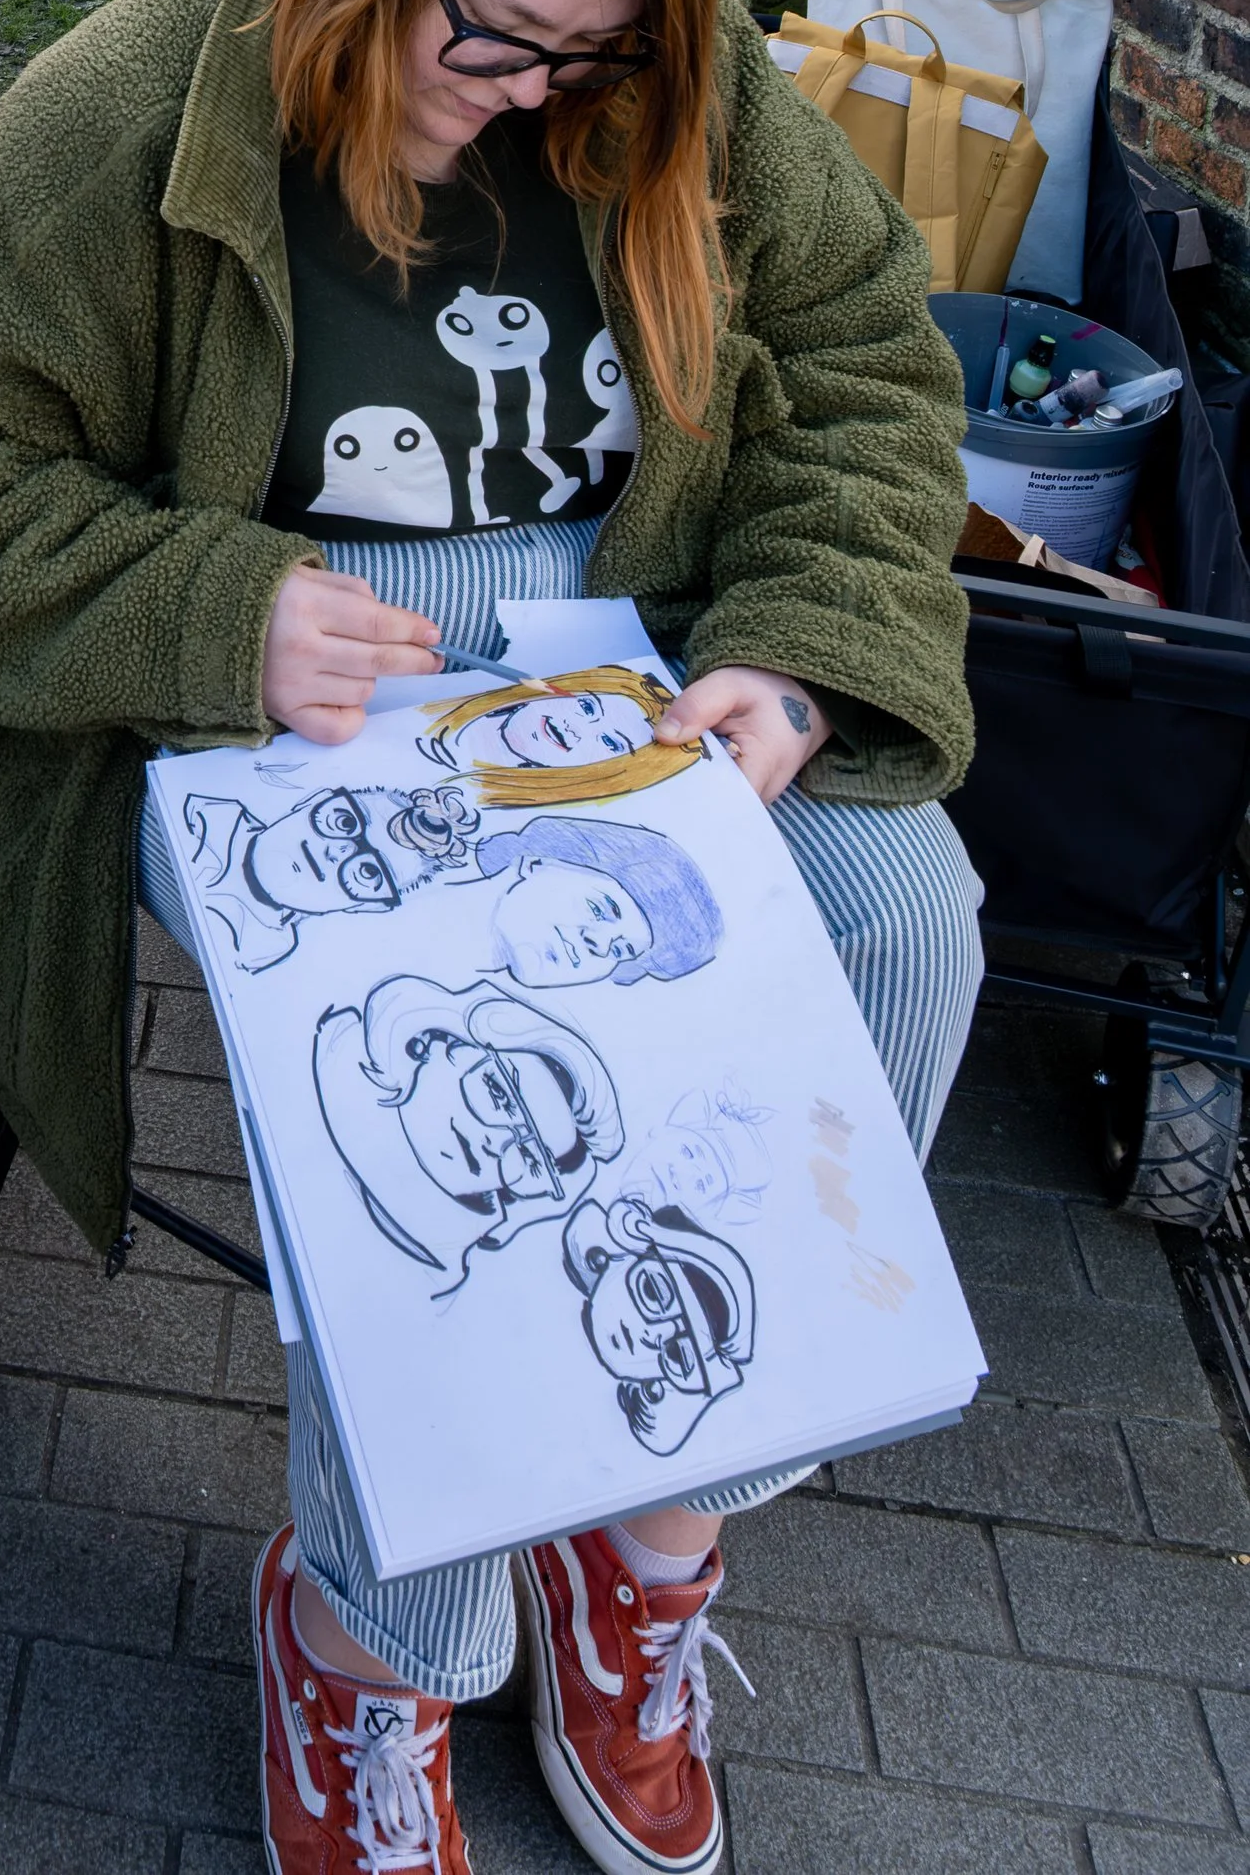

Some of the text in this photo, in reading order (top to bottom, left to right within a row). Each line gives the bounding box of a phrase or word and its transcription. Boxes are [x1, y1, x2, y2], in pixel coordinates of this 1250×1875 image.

[1030, 470, 1071, 482] Interior
[1073, 473, 1101, 483] ready
[1028, 481, 1056, 491] Rough
[371, 1699, 400, 1713] VANS
